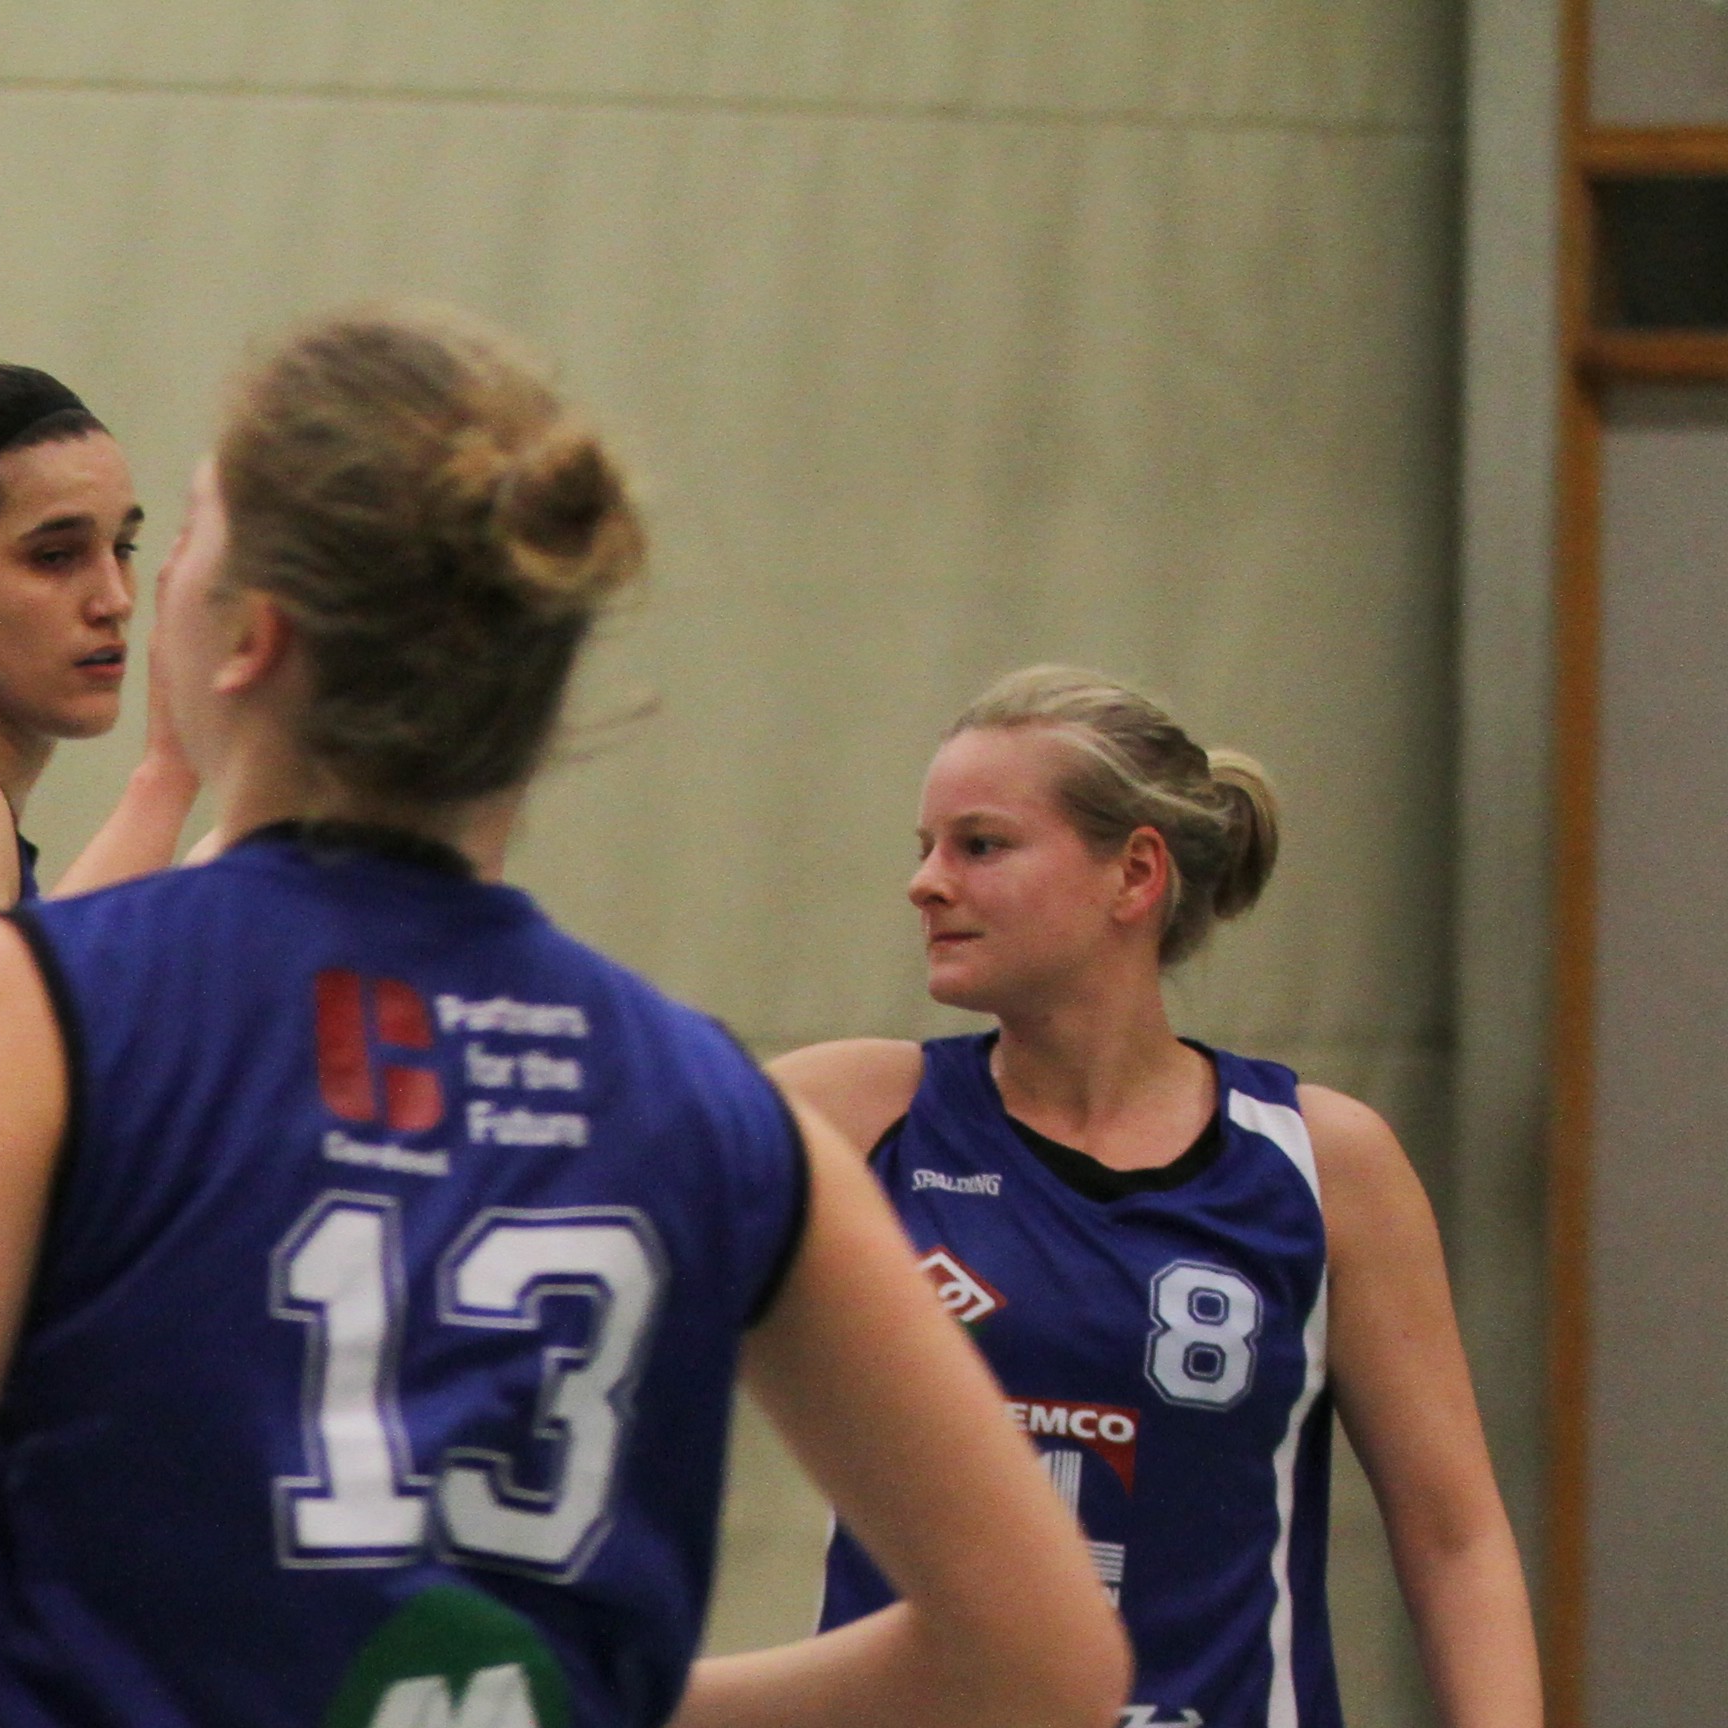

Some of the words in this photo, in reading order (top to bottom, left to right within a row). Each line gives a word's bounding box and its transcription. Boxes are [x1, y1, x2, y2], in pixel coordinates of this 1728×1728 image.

[912, 1168, 1003, 1197] SPALDING
[1144, 1257, 1263, 1414] 8
[268, 1188, 673, 1585] 13
[1004, 1402, 1136, 1443] EMCO
